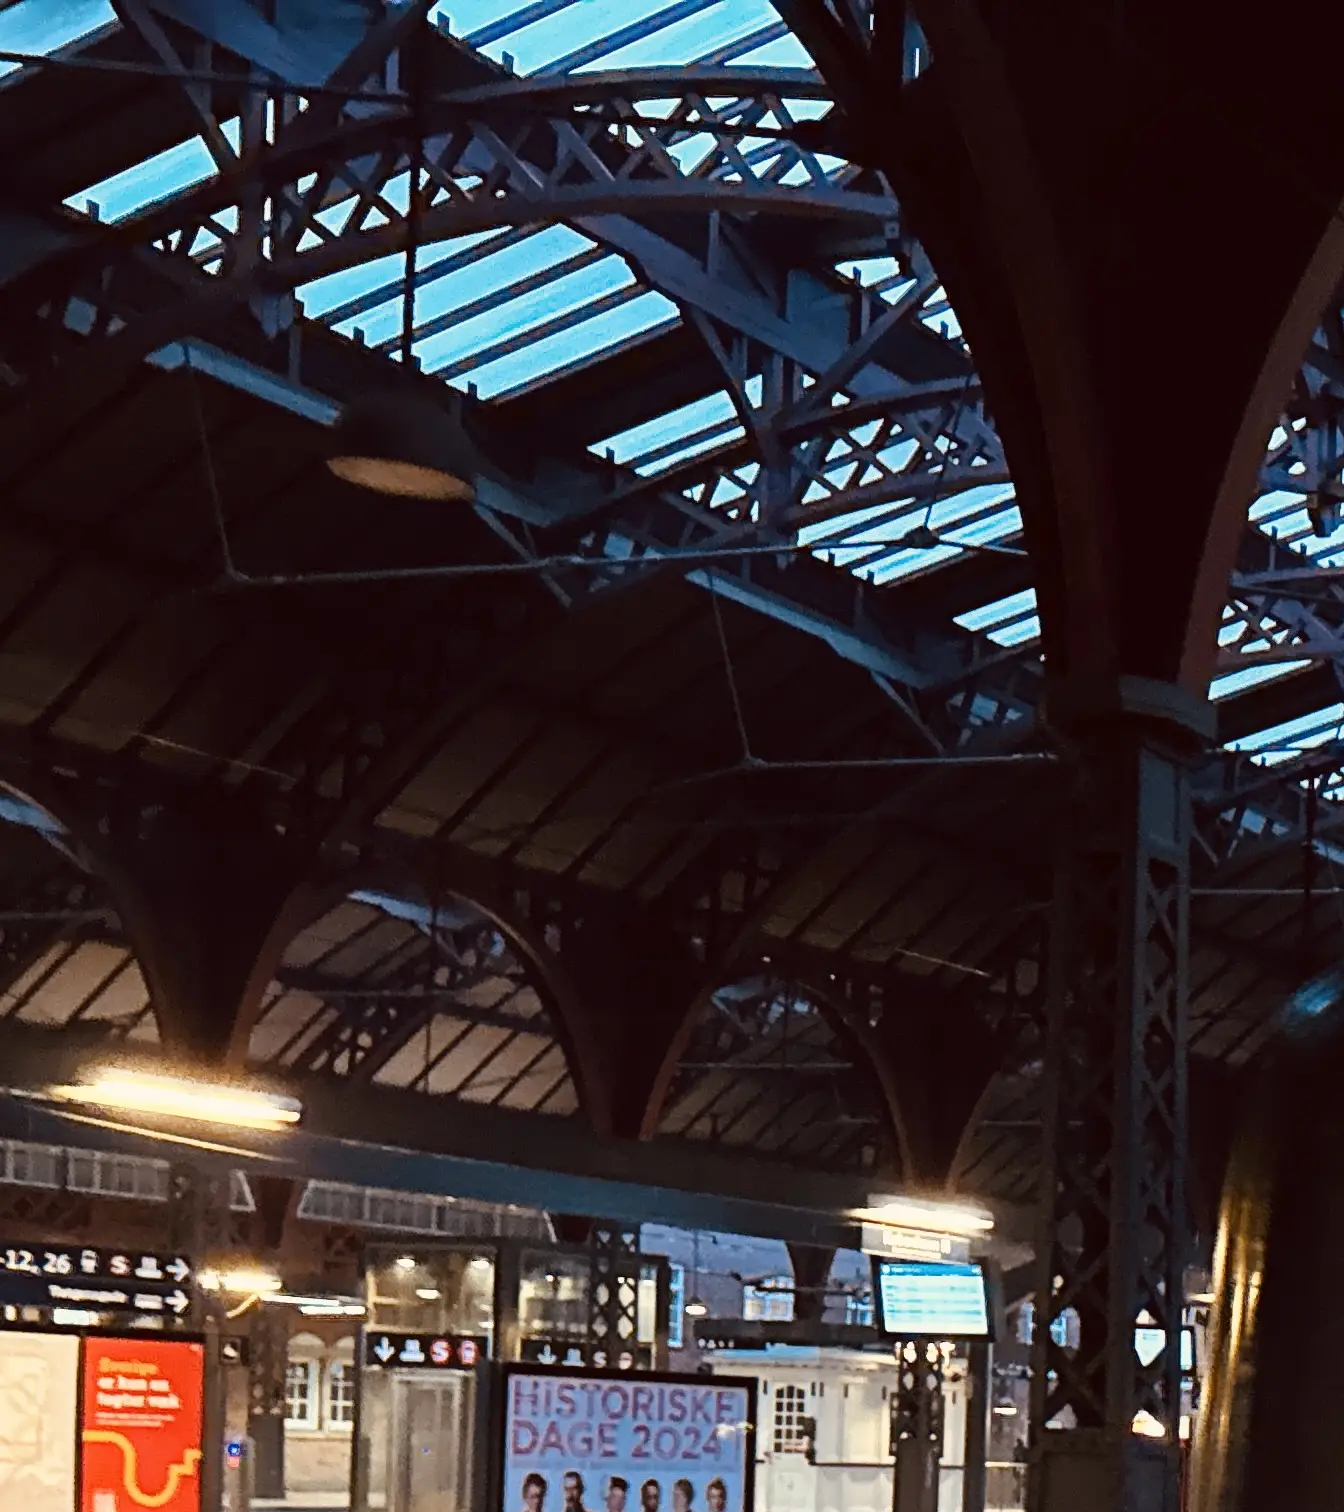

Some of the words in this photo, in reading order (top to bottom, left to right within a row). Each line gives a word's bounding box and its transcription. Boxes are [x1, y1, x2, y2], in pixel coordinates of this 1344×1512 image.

[43, 1252, 72, 1275] 26
[511, 1419, 618, 1458] DAGE
[631, 1424, 723, 1461] 2024
